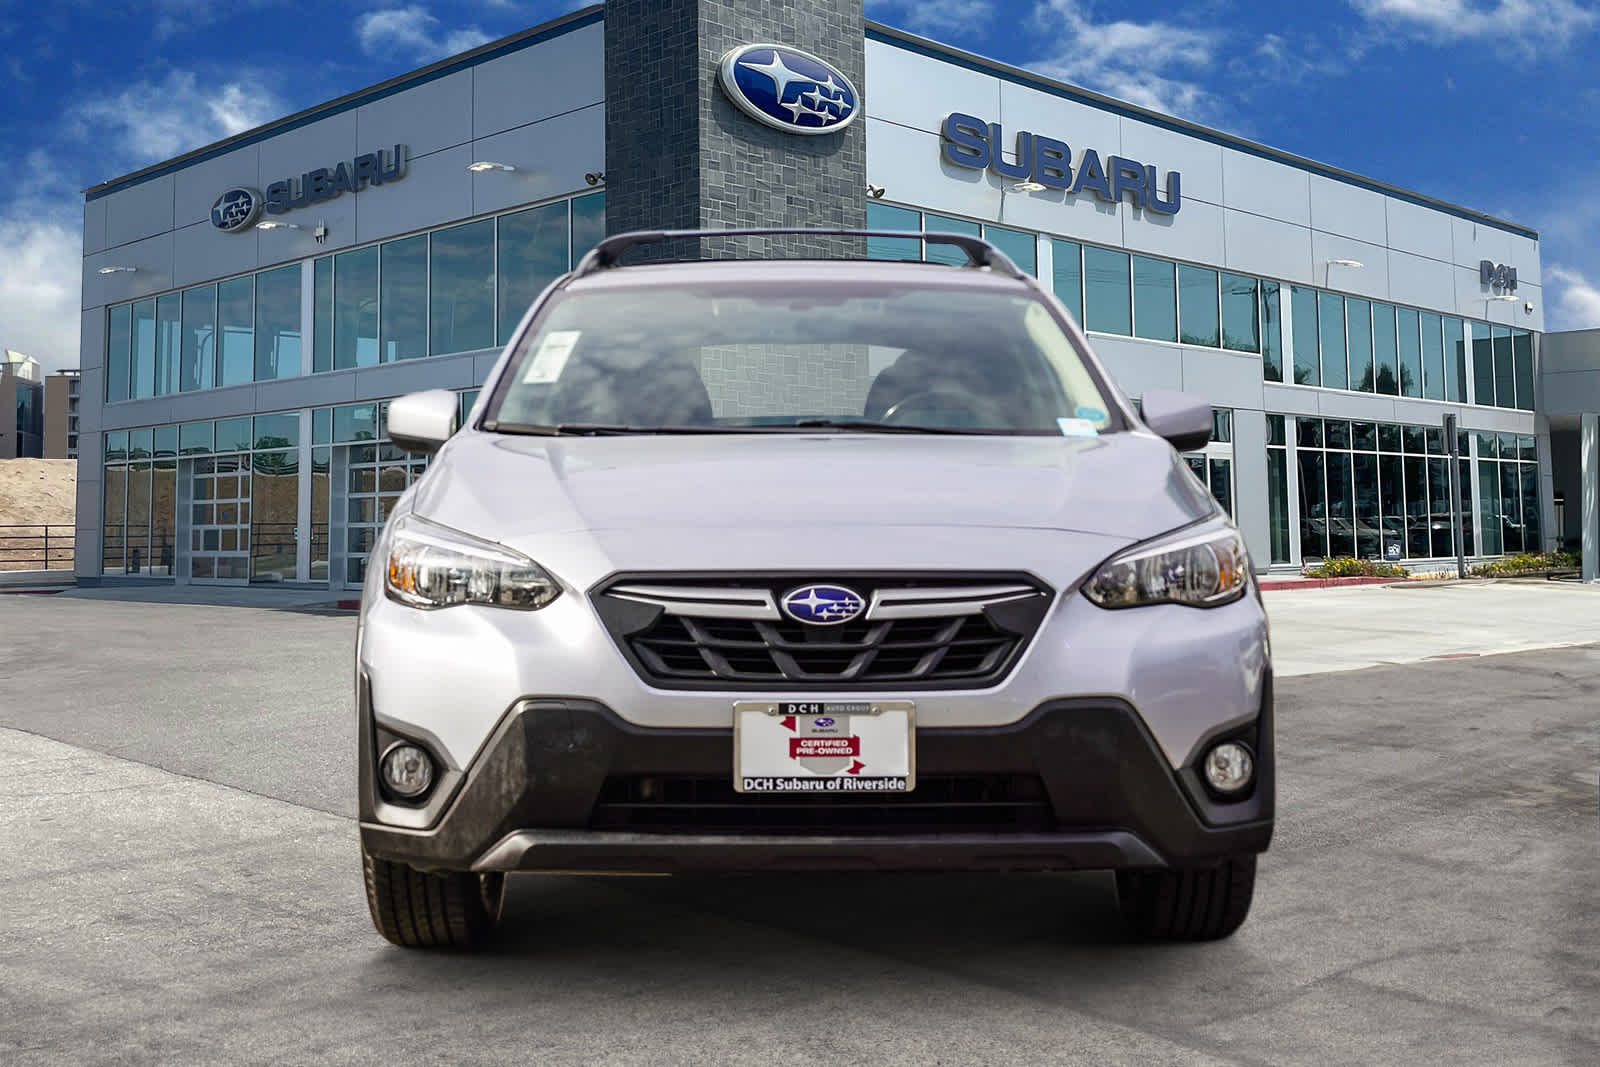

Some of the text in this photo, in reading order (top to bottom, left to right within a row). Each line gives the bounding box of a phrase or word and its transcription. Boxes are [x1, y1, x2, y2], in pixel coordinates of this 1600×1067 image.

[266, 143, 406, 215] SUBARU
[941, 111, 1182, 215] SUBARU
[743, 777, 905, 790] DCH Subaru of Riverside
